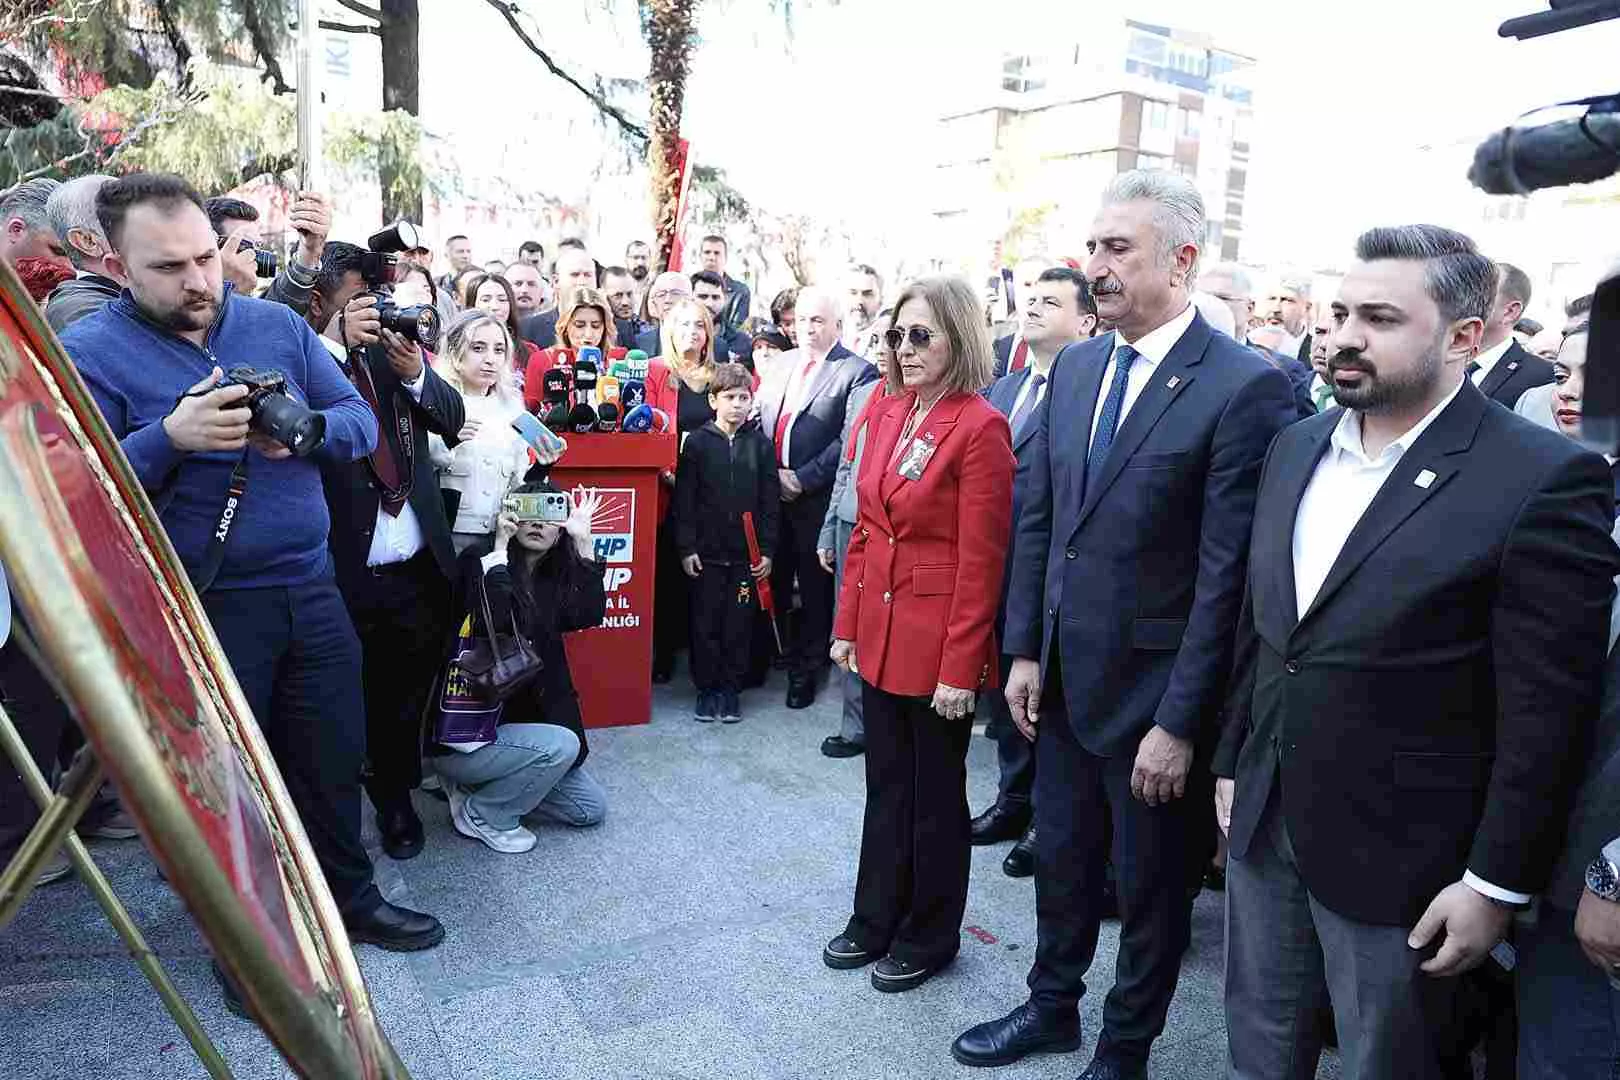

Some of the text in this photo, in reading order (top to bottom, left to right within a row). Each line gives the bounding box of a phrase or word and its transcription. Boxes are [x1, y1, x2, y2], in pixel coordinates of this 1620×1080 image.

[215, 497, 238, 542] SONY
[592, 538, 626, 556] HP
[600, 613, 639, 628] NLIĞI
